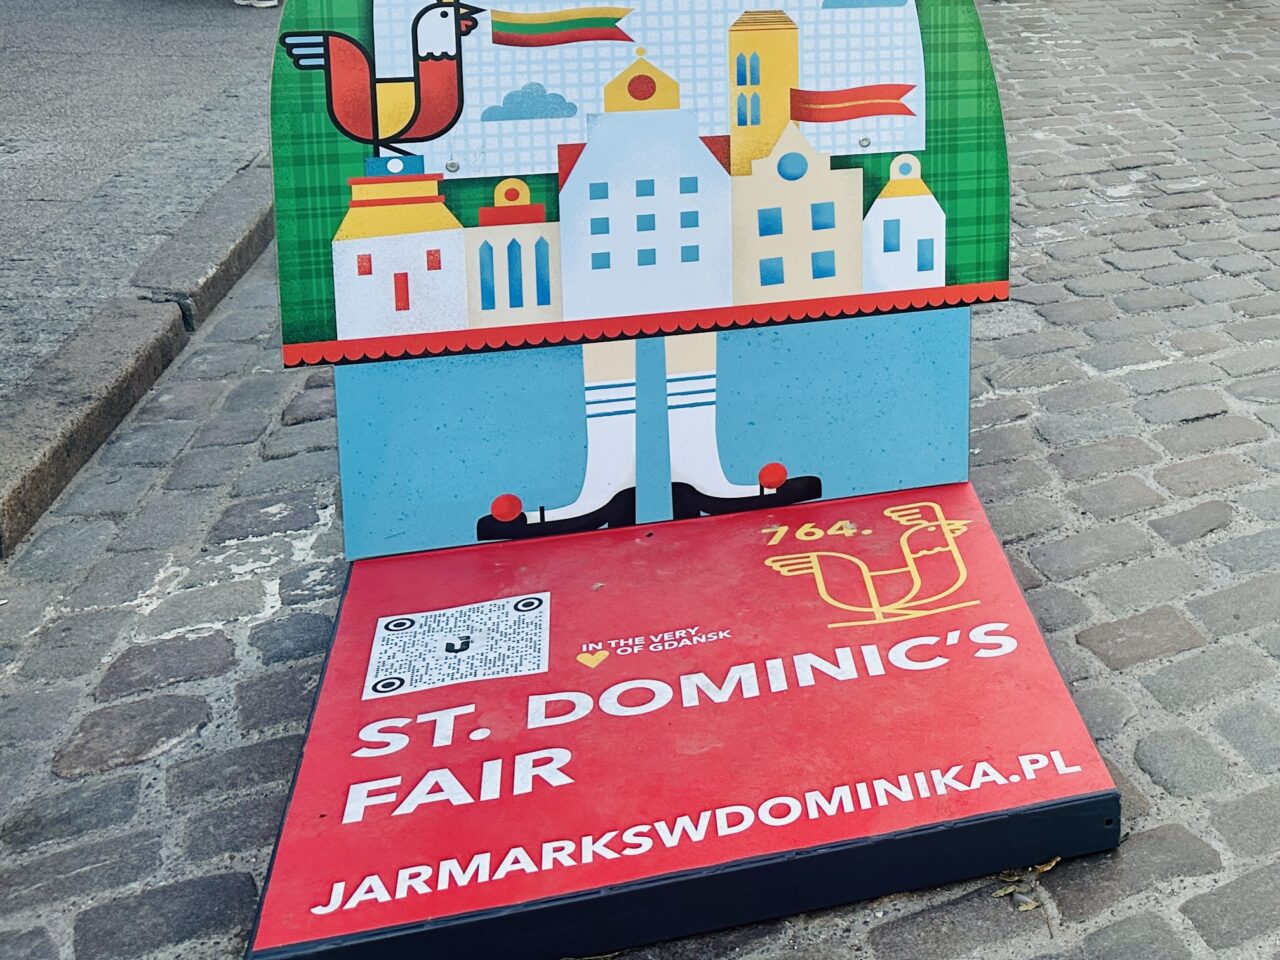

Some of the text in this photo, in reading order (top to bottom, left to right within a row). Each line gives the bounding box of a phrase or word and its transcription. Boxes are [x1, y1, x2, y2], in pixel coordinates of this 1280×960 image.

[761, 520, 873, 545] 764.
[582, 626, 700, 652] IN THE VERY
[616, 630, 732, 655] OF GDAŃSK
[351, 622, 1020, 758] ST. DOMINIC'S
[341, 747, 575, 826] FAIR
[310, 749, 1082, 915] JARMARKSWDOMINIKA.PL
